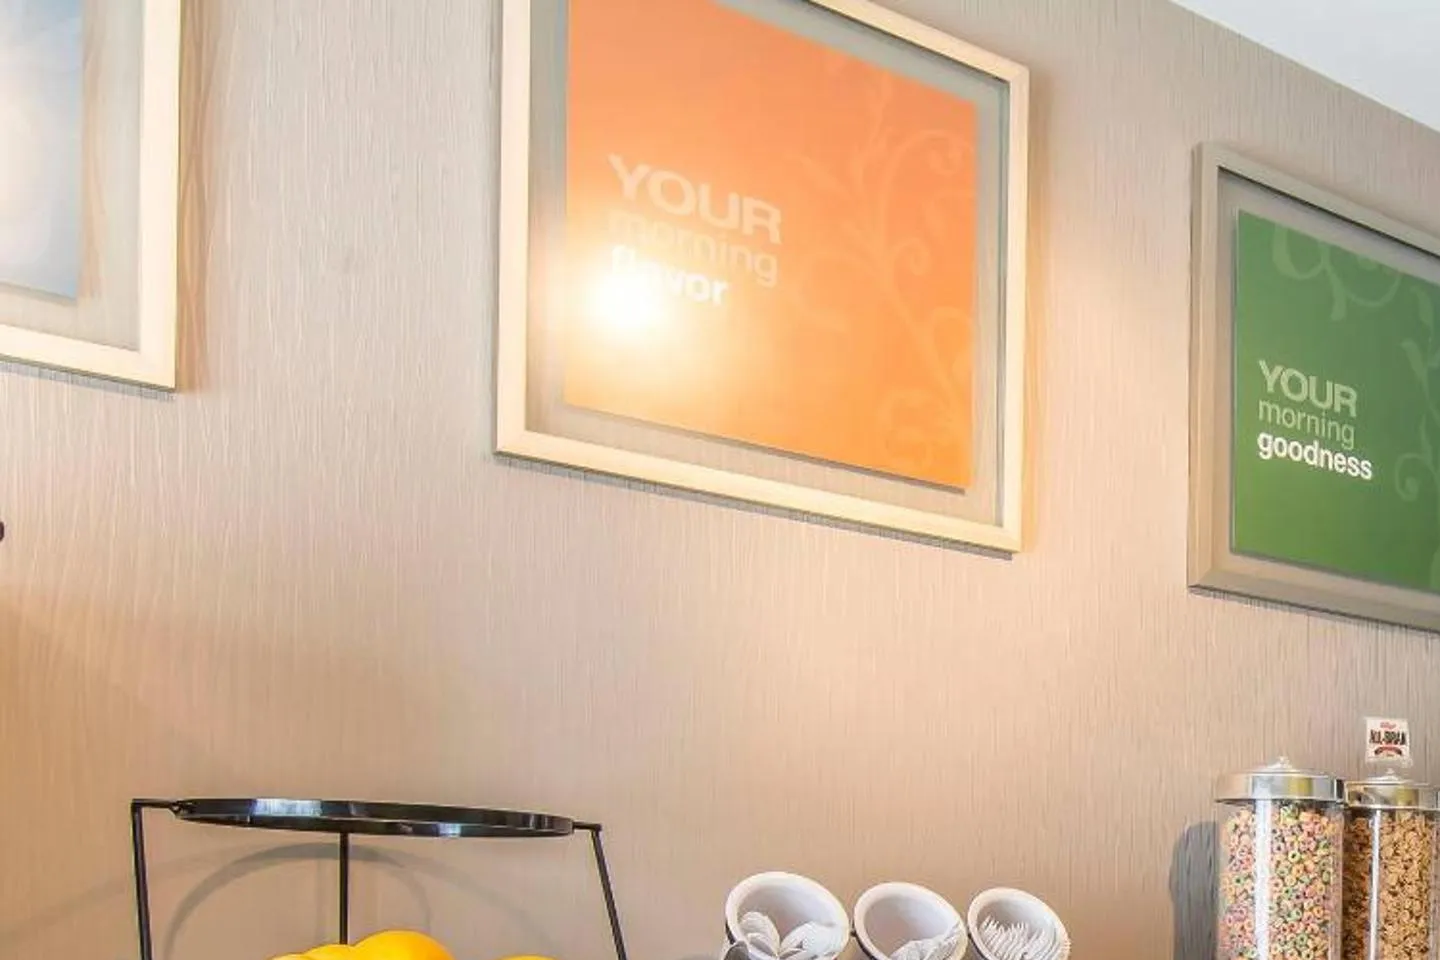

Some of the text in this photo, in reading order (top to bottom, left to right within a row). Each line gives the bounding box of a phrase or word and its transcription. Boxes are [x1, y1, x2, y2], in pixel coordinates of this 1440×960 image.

[607, 152, 783, 245] YOUR
[608, 208, 779, 289] morning
[1258, 359, 1358, 418] YOUR
[1258, 399, 1355, 450] morning
[1257, 431, 1373, 481] goodness
